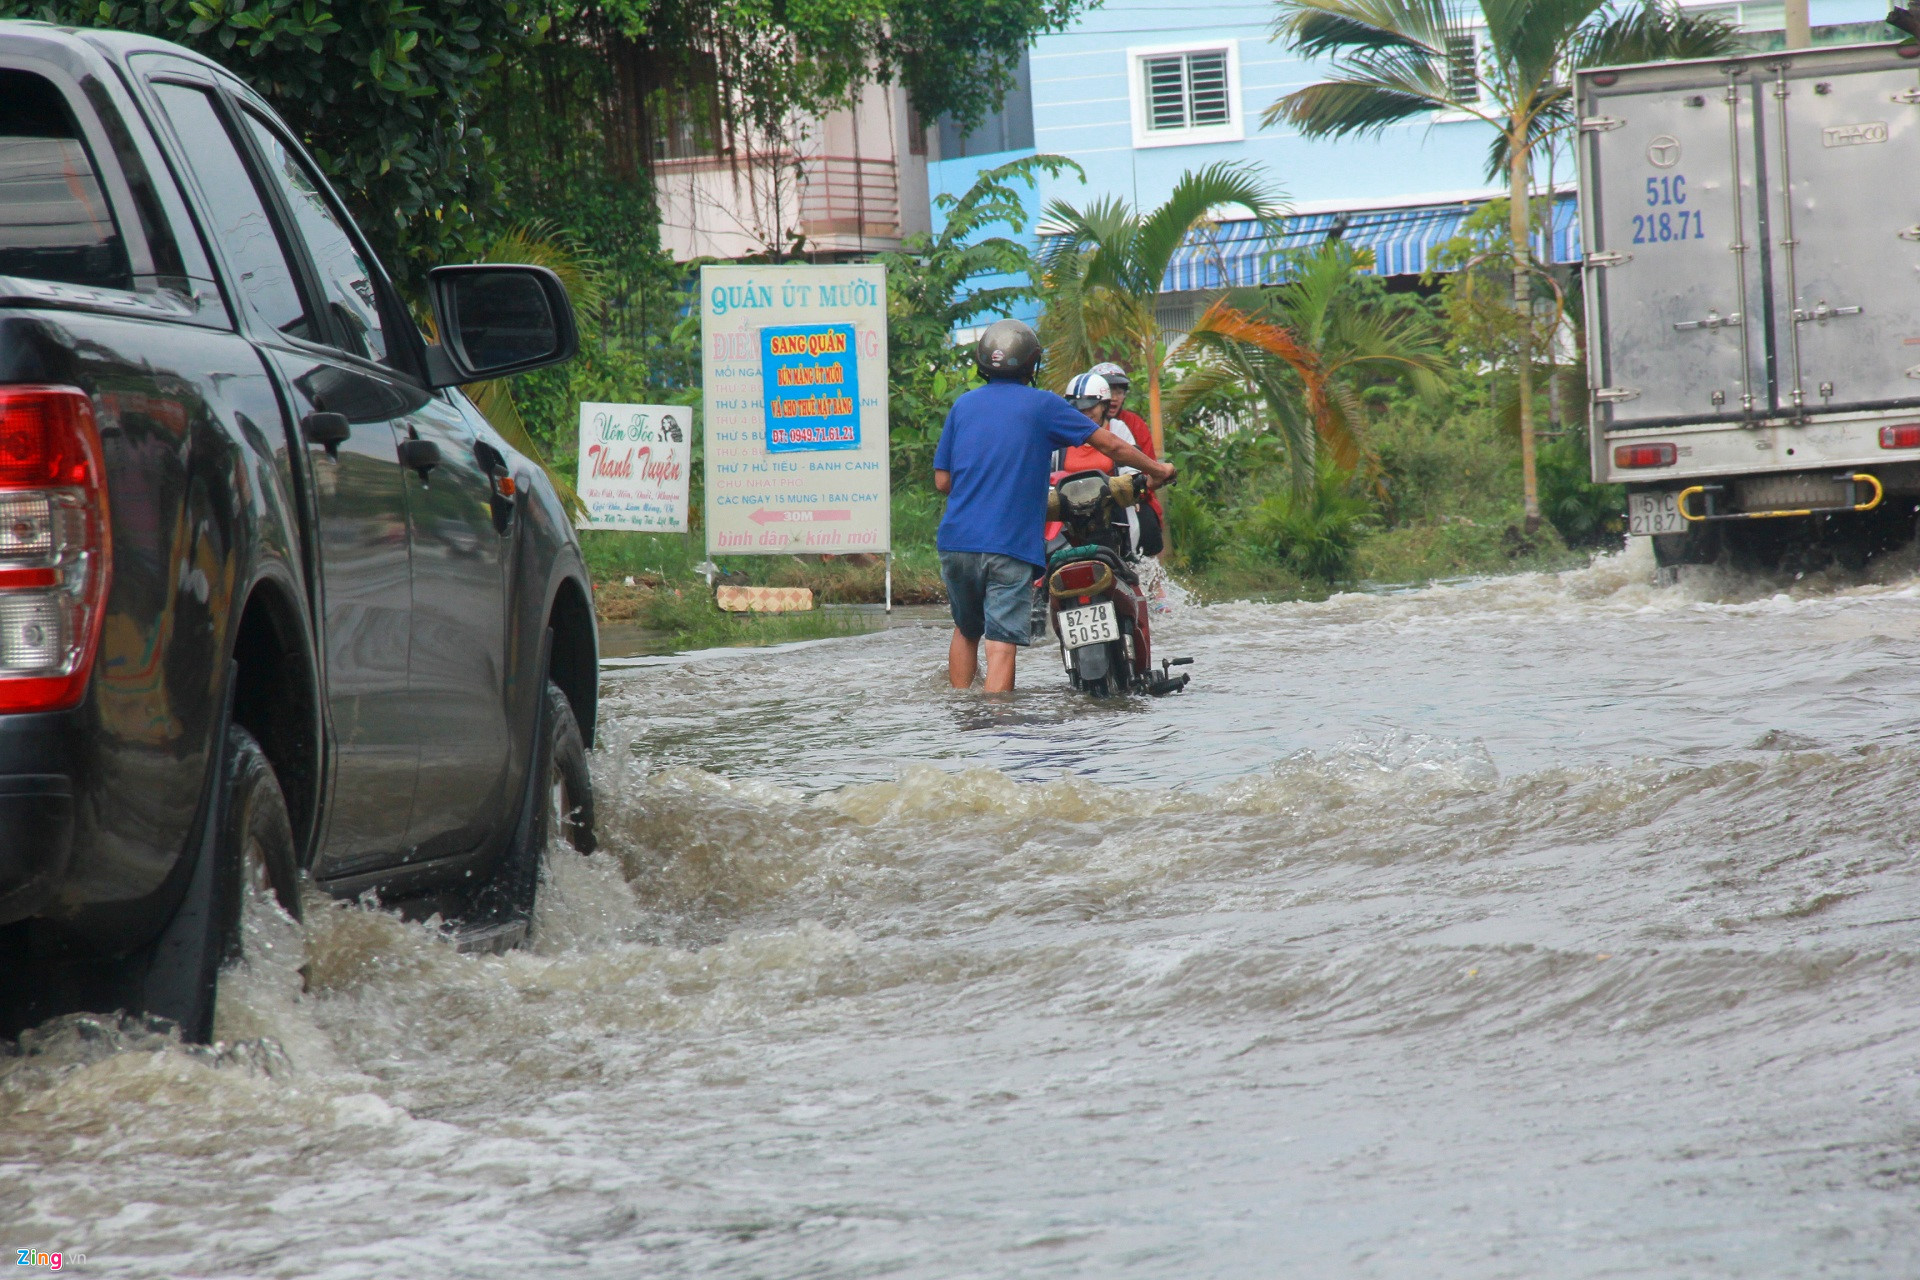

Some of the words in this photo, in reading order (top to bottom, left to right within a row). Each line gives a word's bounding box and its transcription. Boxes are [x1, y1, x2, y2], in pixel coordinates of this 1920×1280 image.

[1646, 175, 1686, 206] 51C
[1632, 210, 1705, 244] 218.71
[711, 279, 773, 315] QUÁN
[782, 279, 812, 308] ÚT
[819, 278, 877, 307] MƯỜI
[771, 335, 806, 355] SANG
[808, 328, 846, 357] QUÁN
[741, 400, 747, 409] 3
[783, 399, 797, 417] CHO
[627, 413, 654, 442] Tóc
[742, 431, 748, 440] 5
[790, 426, 854, 442] 0949.71.61.21
[588, 444, 632, 479] Thanh
[743, 463, 748, 472] 7
[845, 461, 879, 471] CANH
[775, 494, 785, 503] 15
[851, 493, 878, 502] CHAY
[783, 512, 813, 522] 30M
[717, 531, 752, 546] bình
[758, 530, 789, 545] dân
[805, 529, 841, 545] kính
[848, 528, 877, 545] mời
[1069, 622, 1110, 645] 5055
